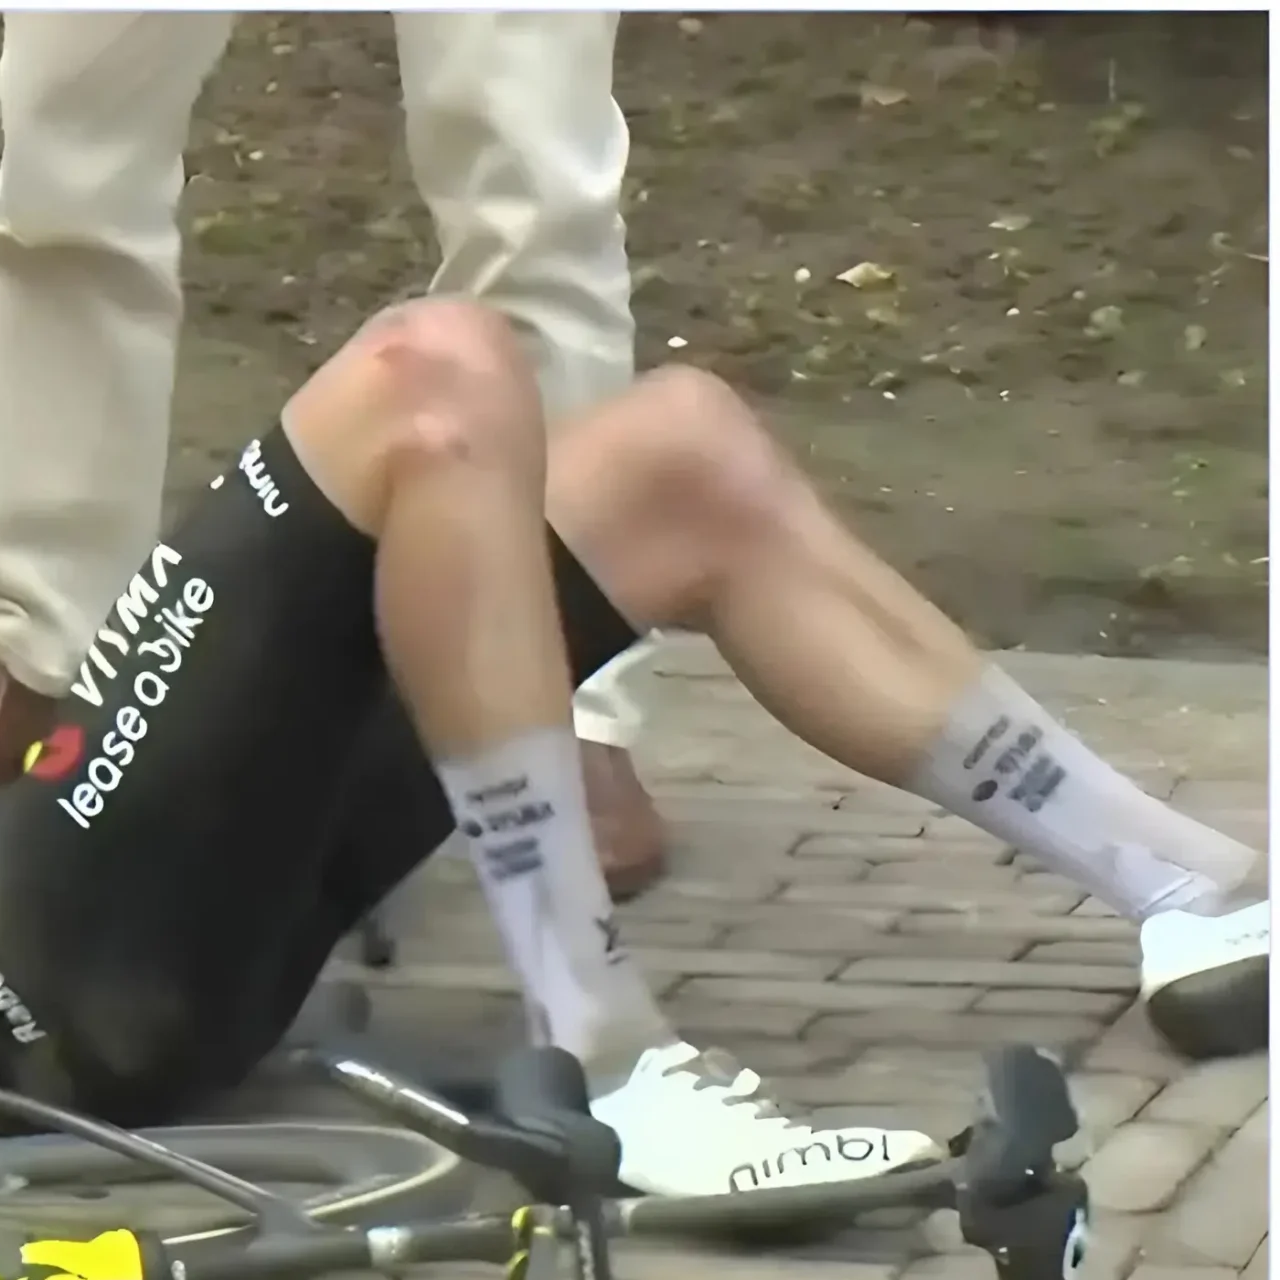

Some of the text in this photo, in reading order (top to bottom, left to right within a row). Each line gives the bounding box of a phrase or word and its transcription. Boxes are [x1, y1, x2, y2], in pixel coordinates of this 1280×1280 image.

[71, 543, 183, 707] VISMA
[57, 706, 148, 829] lease
[134, 671, 170, 706] a
[729, 1134, 890, 1193] nimbl
